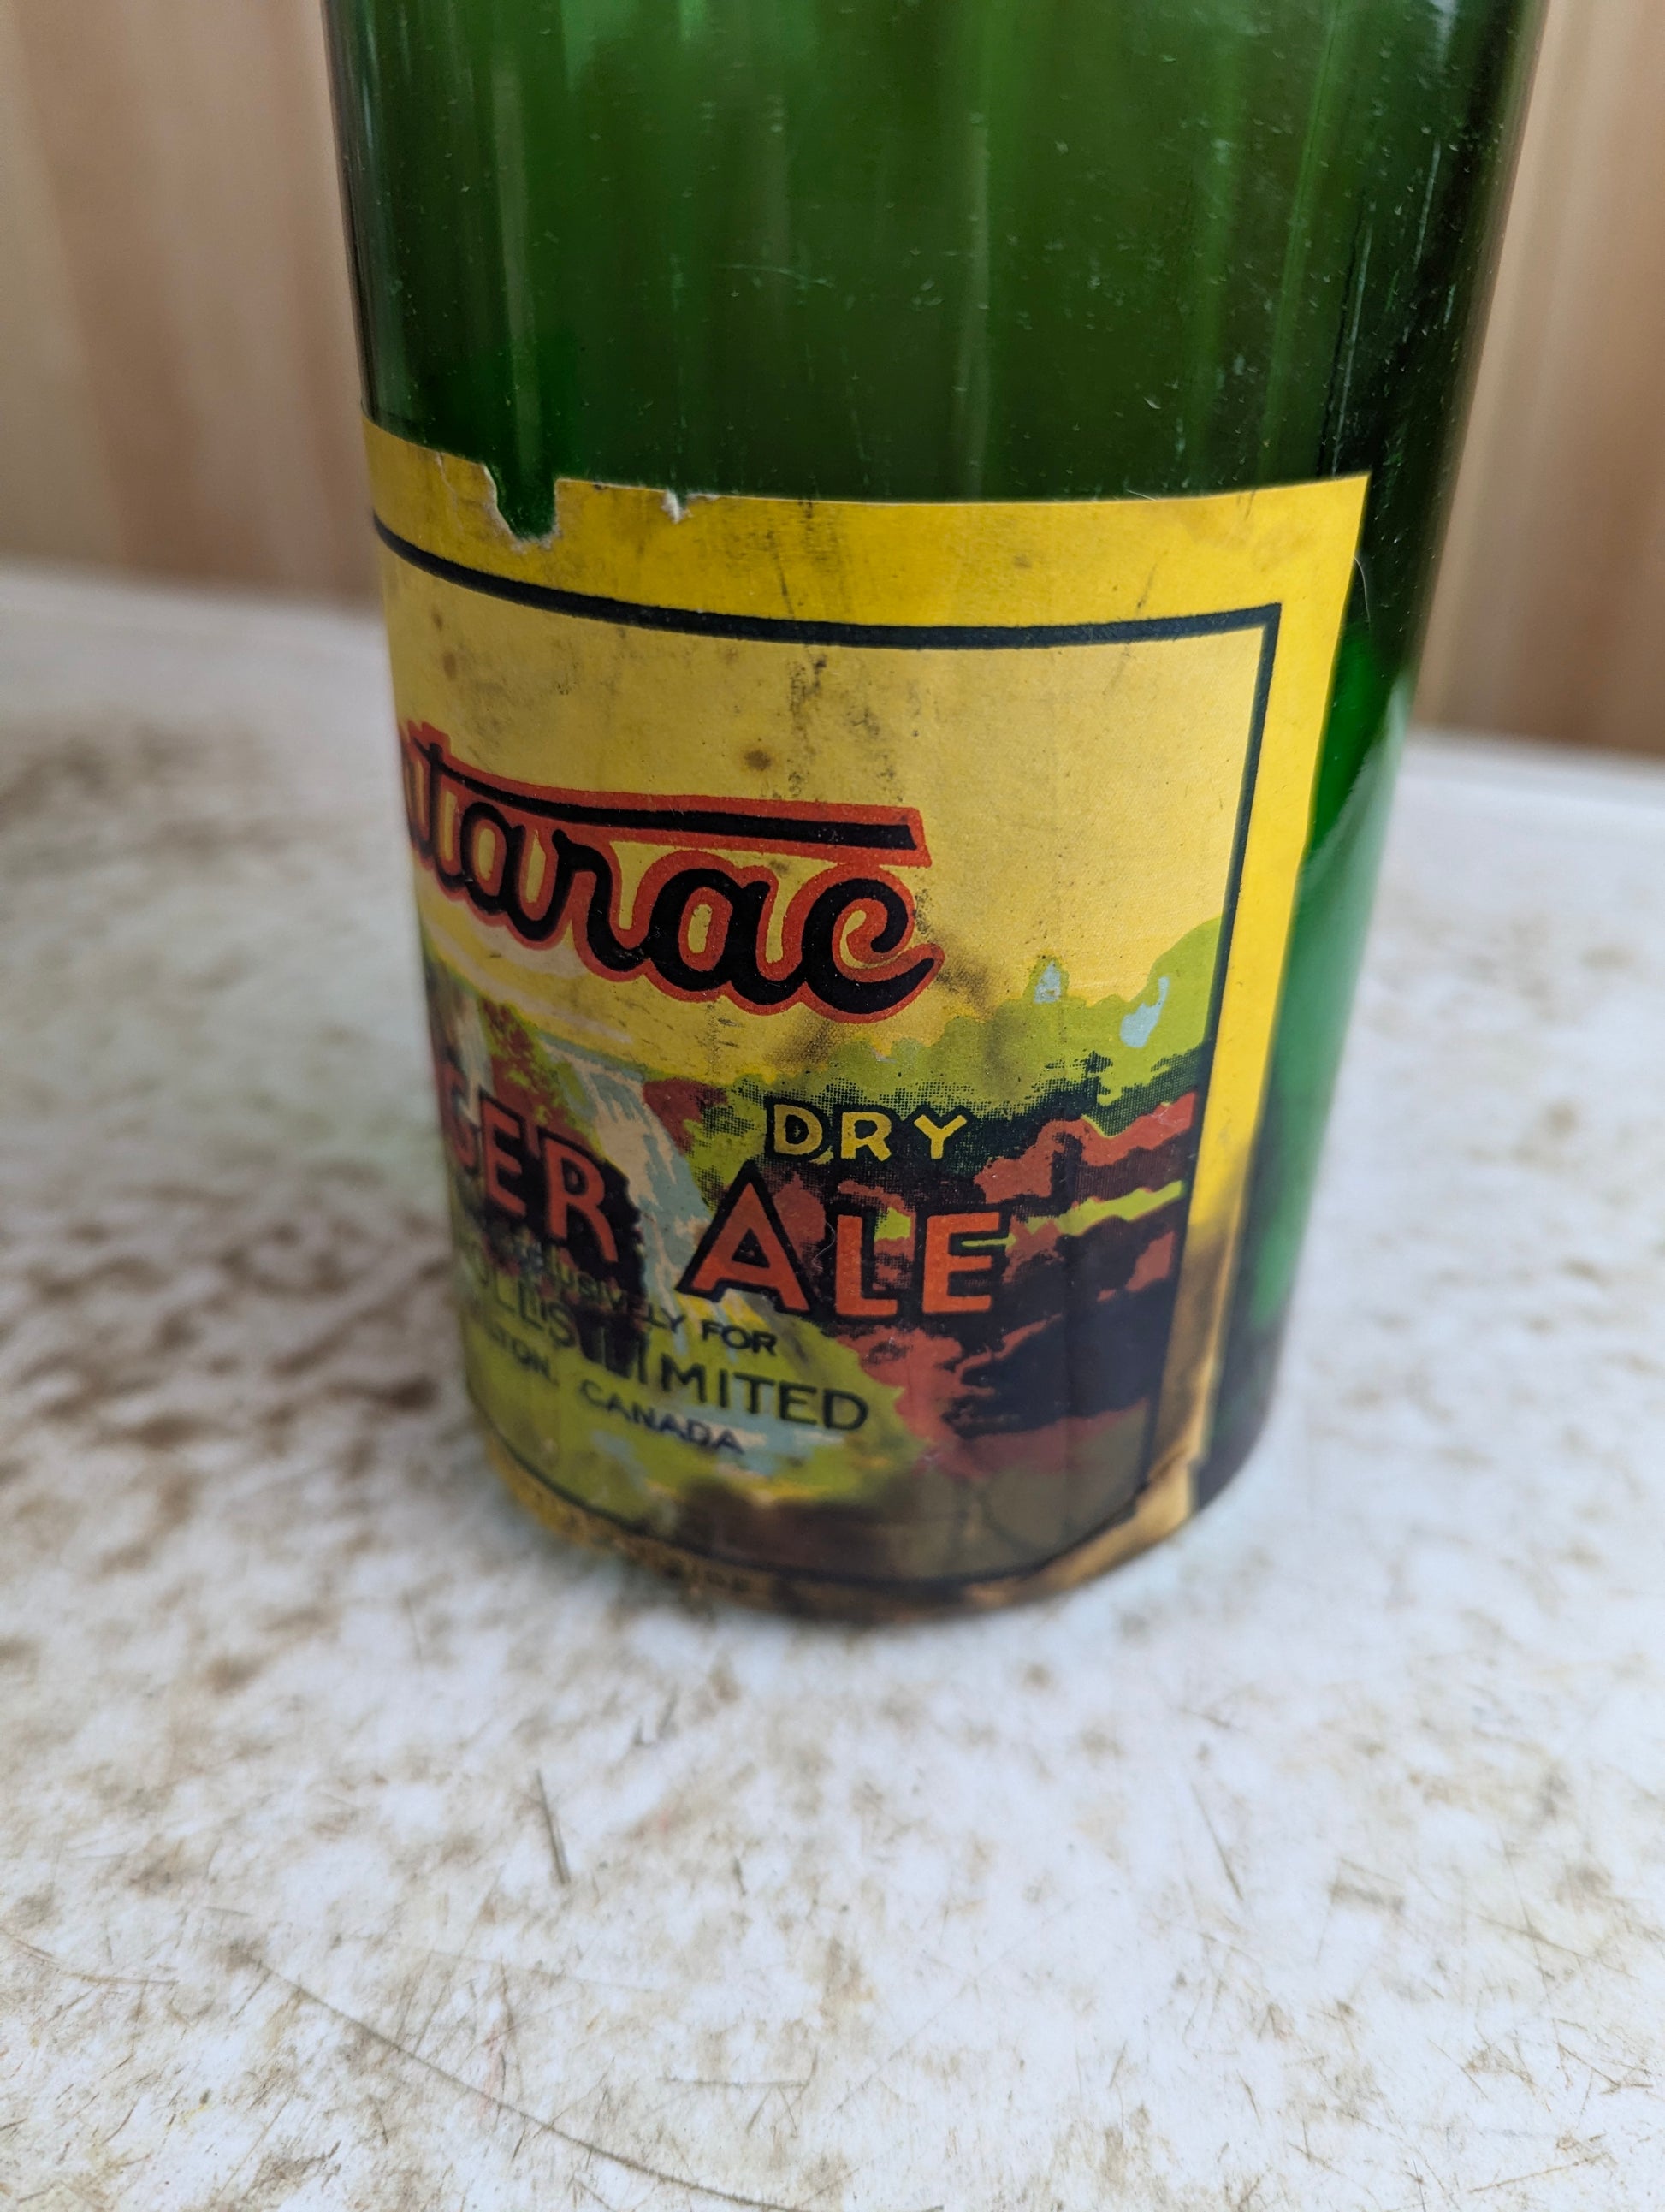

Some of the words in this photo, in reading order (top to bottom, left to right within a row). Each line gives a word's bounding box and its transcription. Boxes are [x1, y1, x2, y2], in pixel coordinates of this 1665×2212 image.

[771, 1101, 969, 1163] DRY
[684, 1172, 1004, 1318] ALE
[701, 1319, 777, 1355] FOR
[579, 1379, 746, 1455] CANADA
